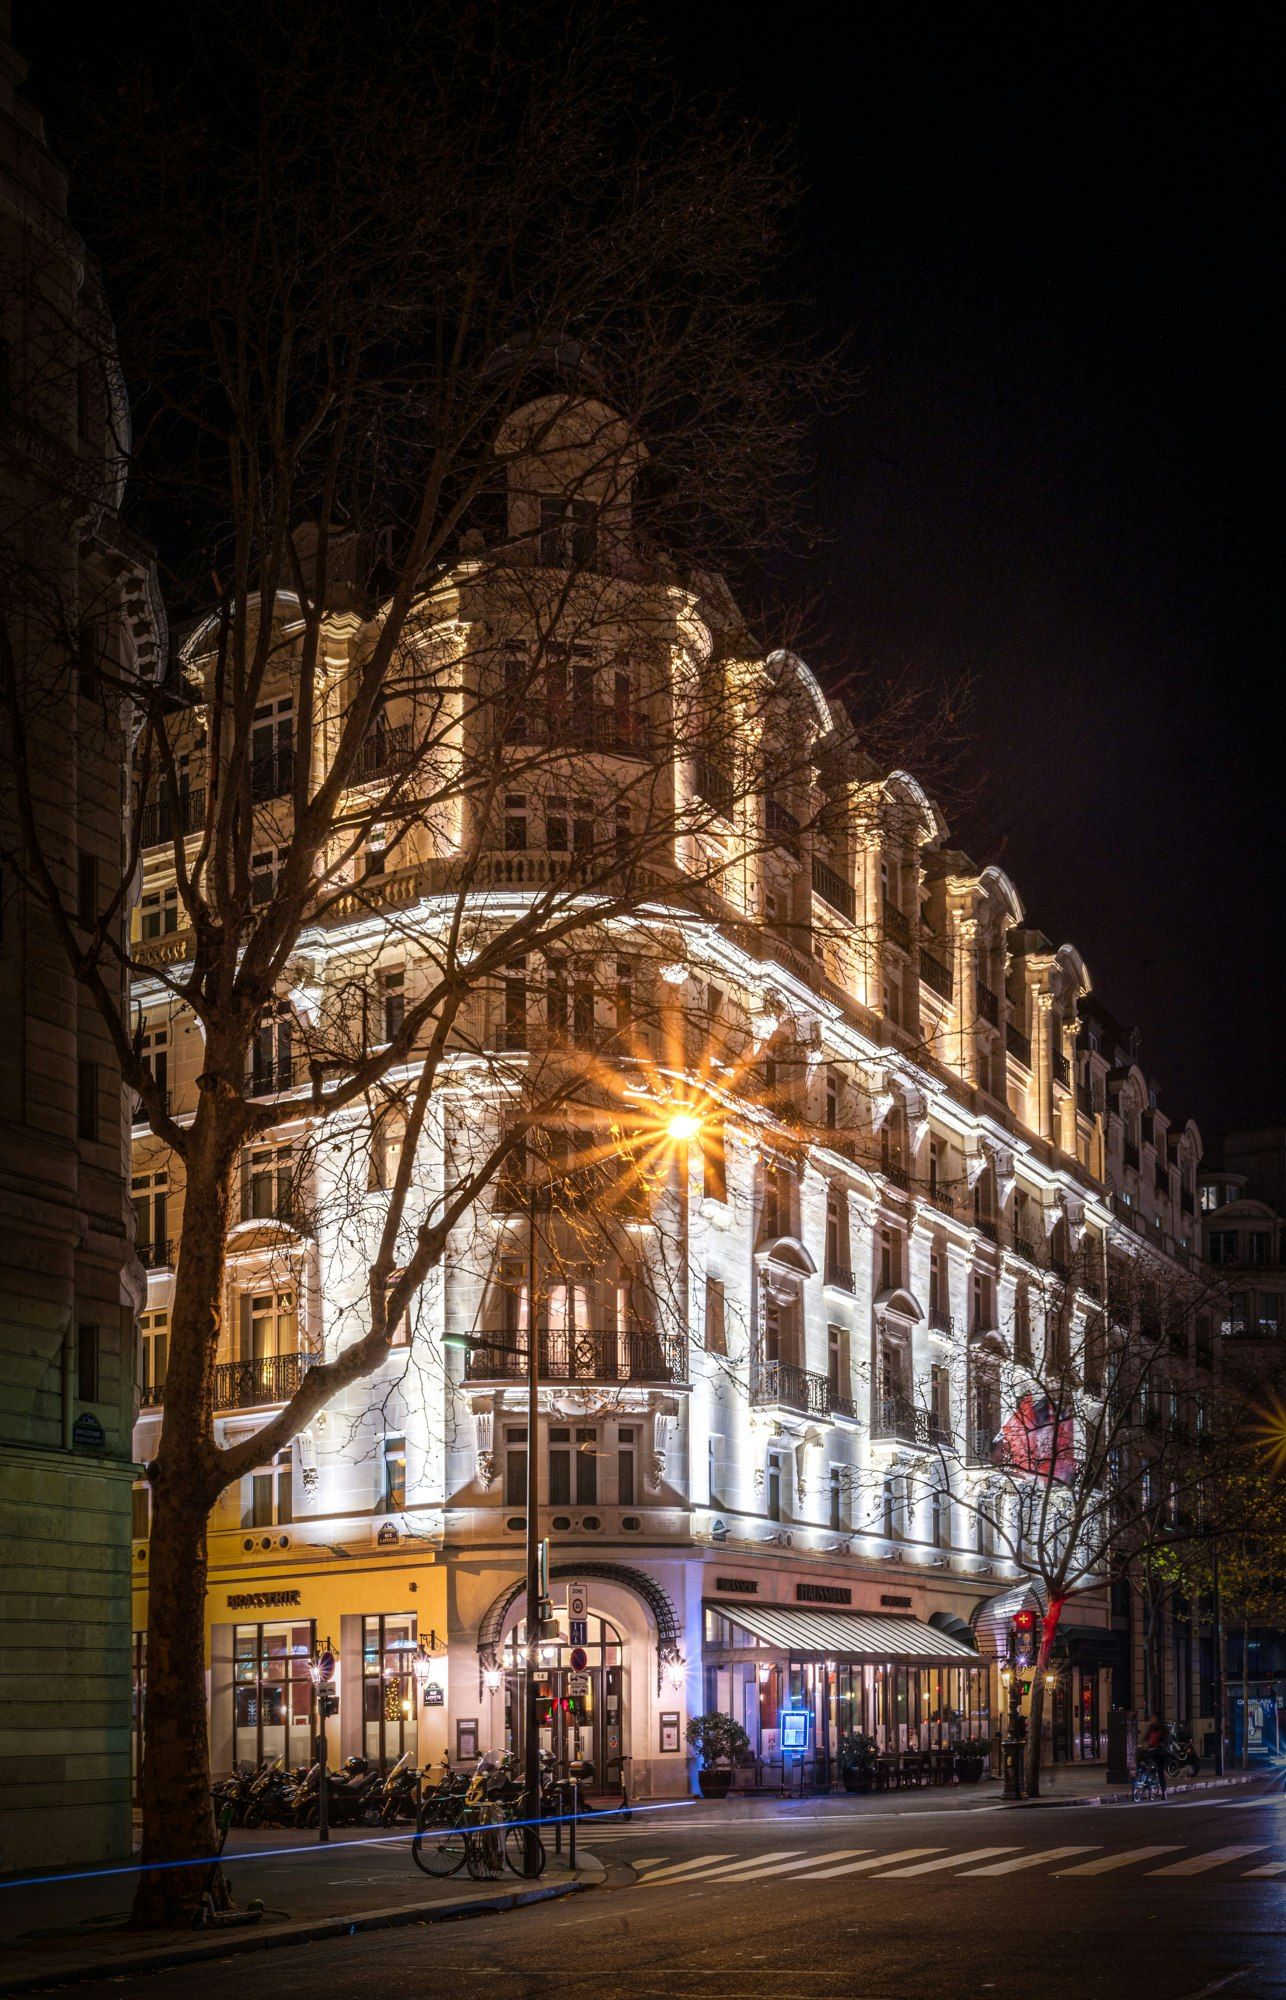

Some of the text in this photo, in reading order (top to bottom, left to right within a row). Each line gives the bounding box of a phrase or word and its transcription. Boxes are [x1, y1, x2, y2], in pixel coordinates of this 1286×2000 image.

[716, 1578, 760, 1593] BRASSERIE
[797, 1584, 852, 1604] HAUSSMANN
[227, 1589, 301, 1611] BRASSERIE
